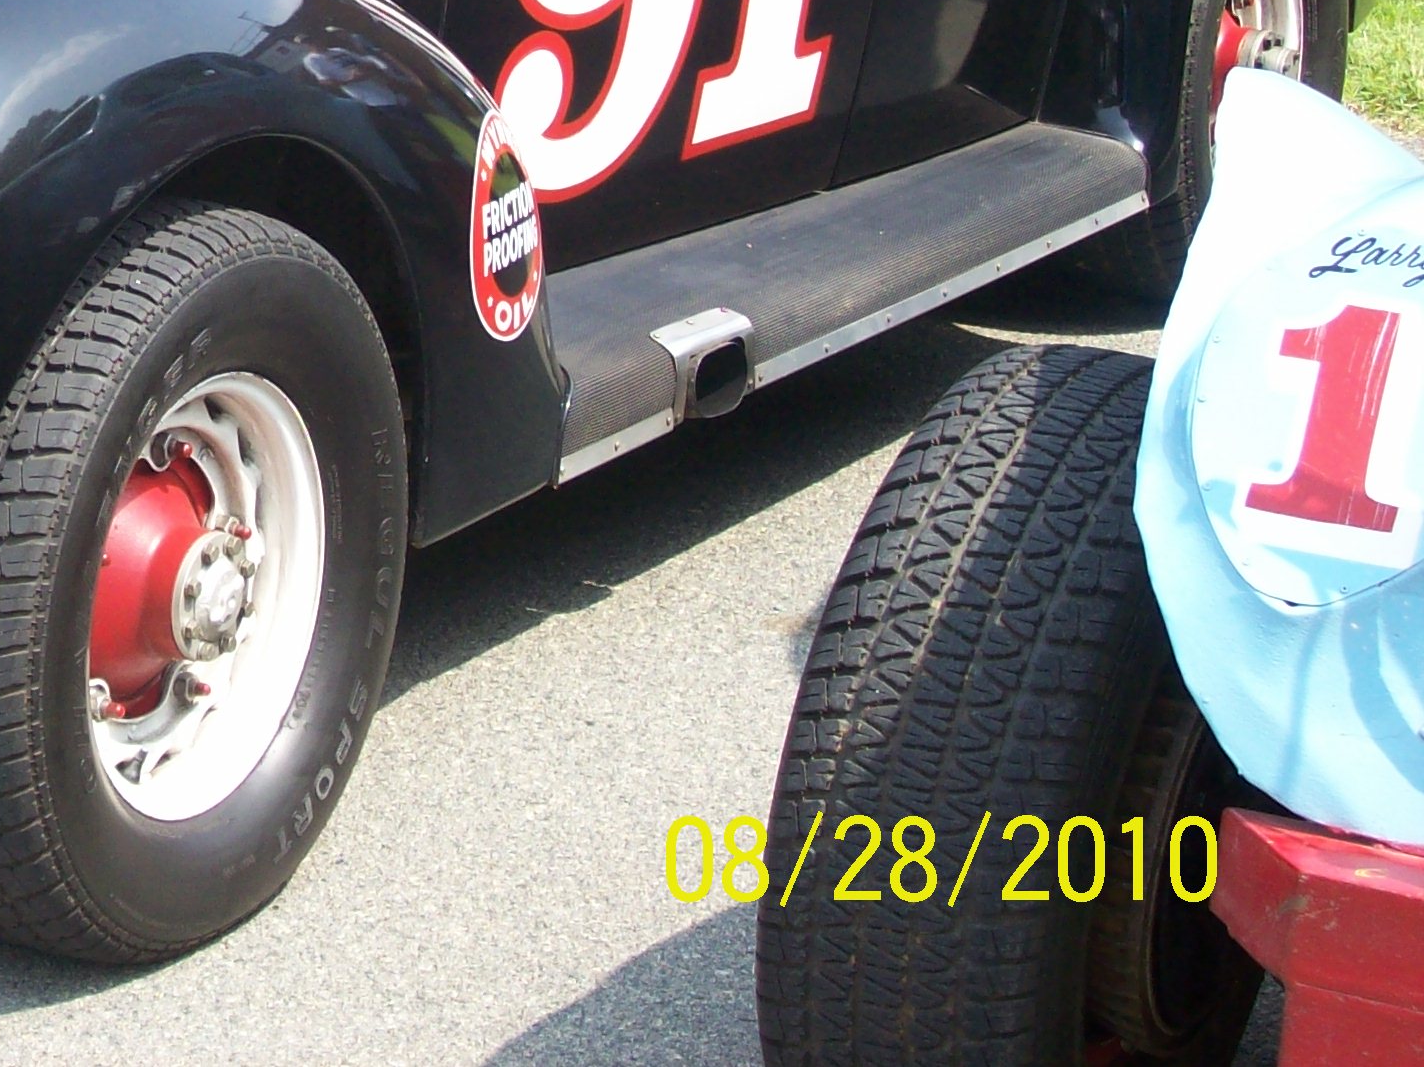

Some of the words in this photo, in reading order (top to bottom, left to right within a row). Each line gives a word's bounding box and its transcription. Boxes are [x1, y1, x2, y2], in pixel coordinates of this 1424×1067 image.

[482, 182, 536, 240] FRICTION
[483, 214, 539, 278] PROOFING
[495, 291, 534, 332] OIL
[1244, 304, 1402, 533] 1
[273, 674, 369, 865] SPORT
